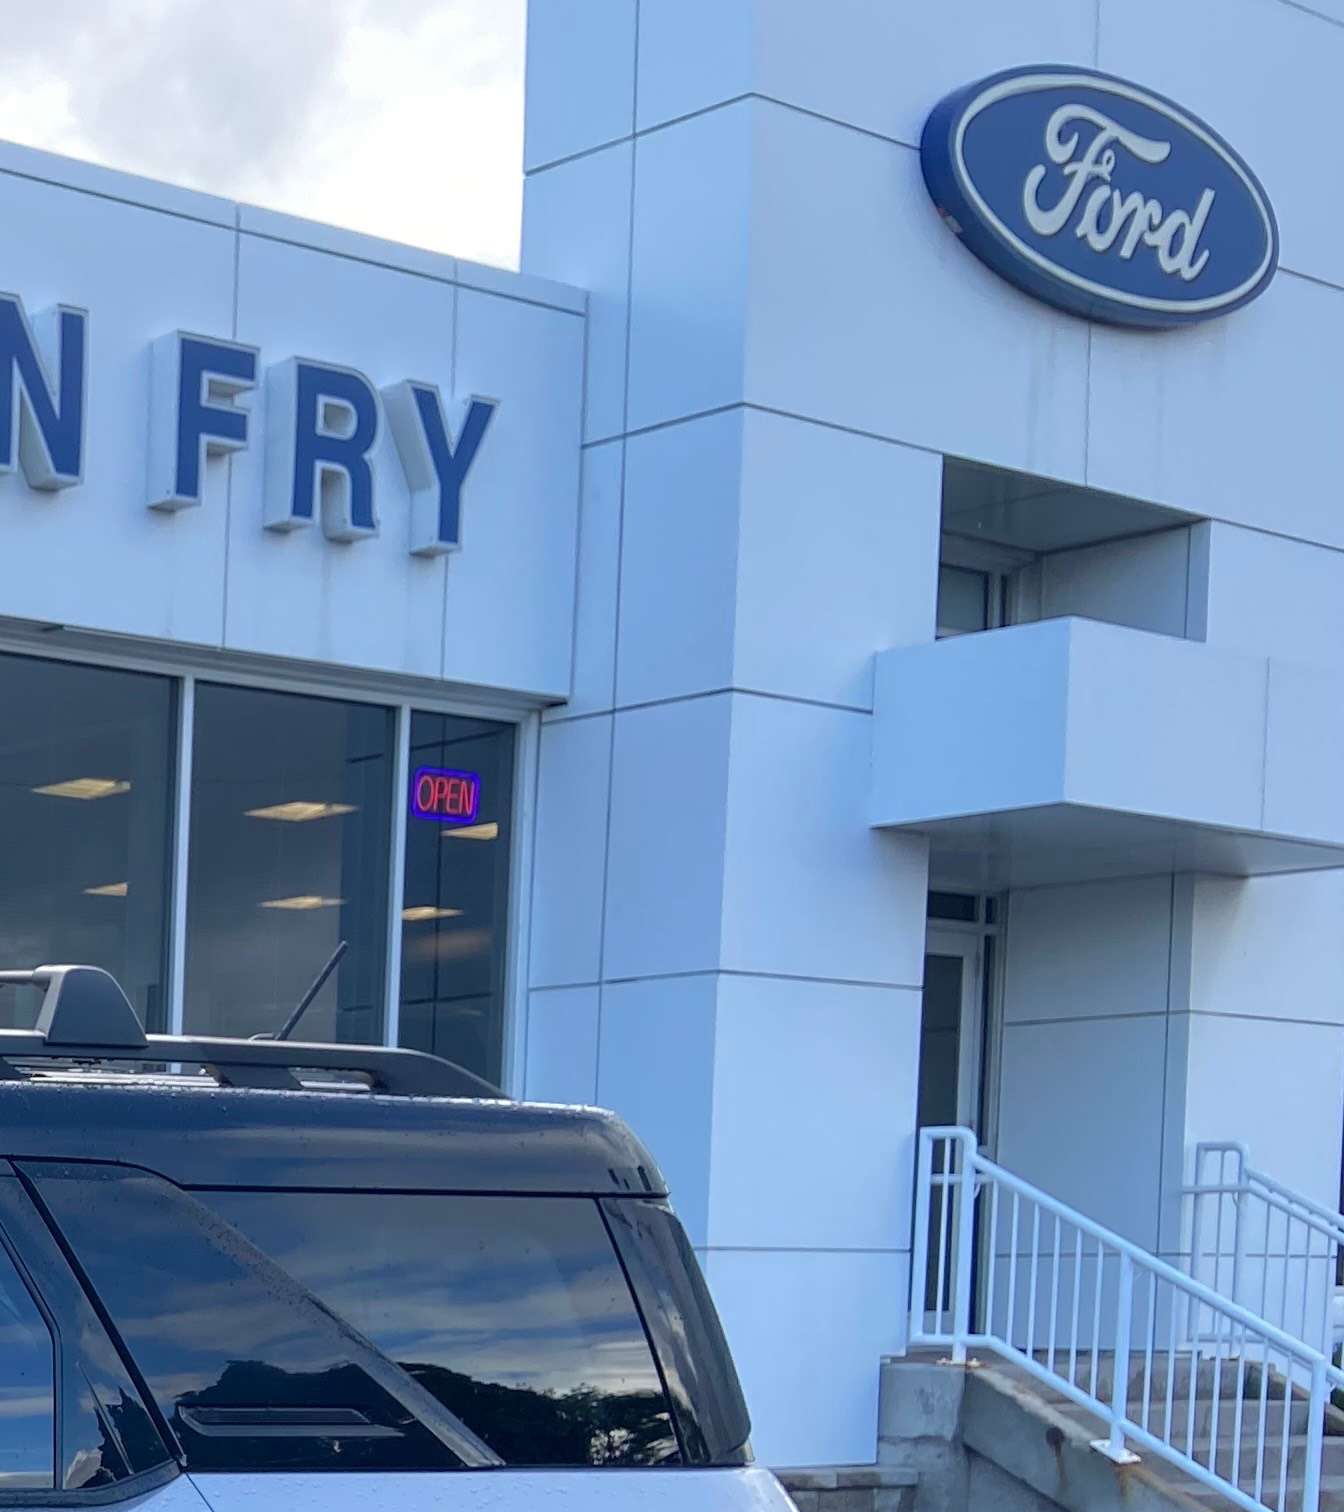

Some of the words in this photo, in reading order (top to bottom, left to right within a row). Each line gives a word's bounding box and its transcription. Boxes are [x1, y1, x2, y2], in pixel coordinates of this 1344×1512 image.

[1023, 103, 1216, 281] Ford
[148, 329, 501, 558] FRY
[417, 775, 475, 817] OPEN
